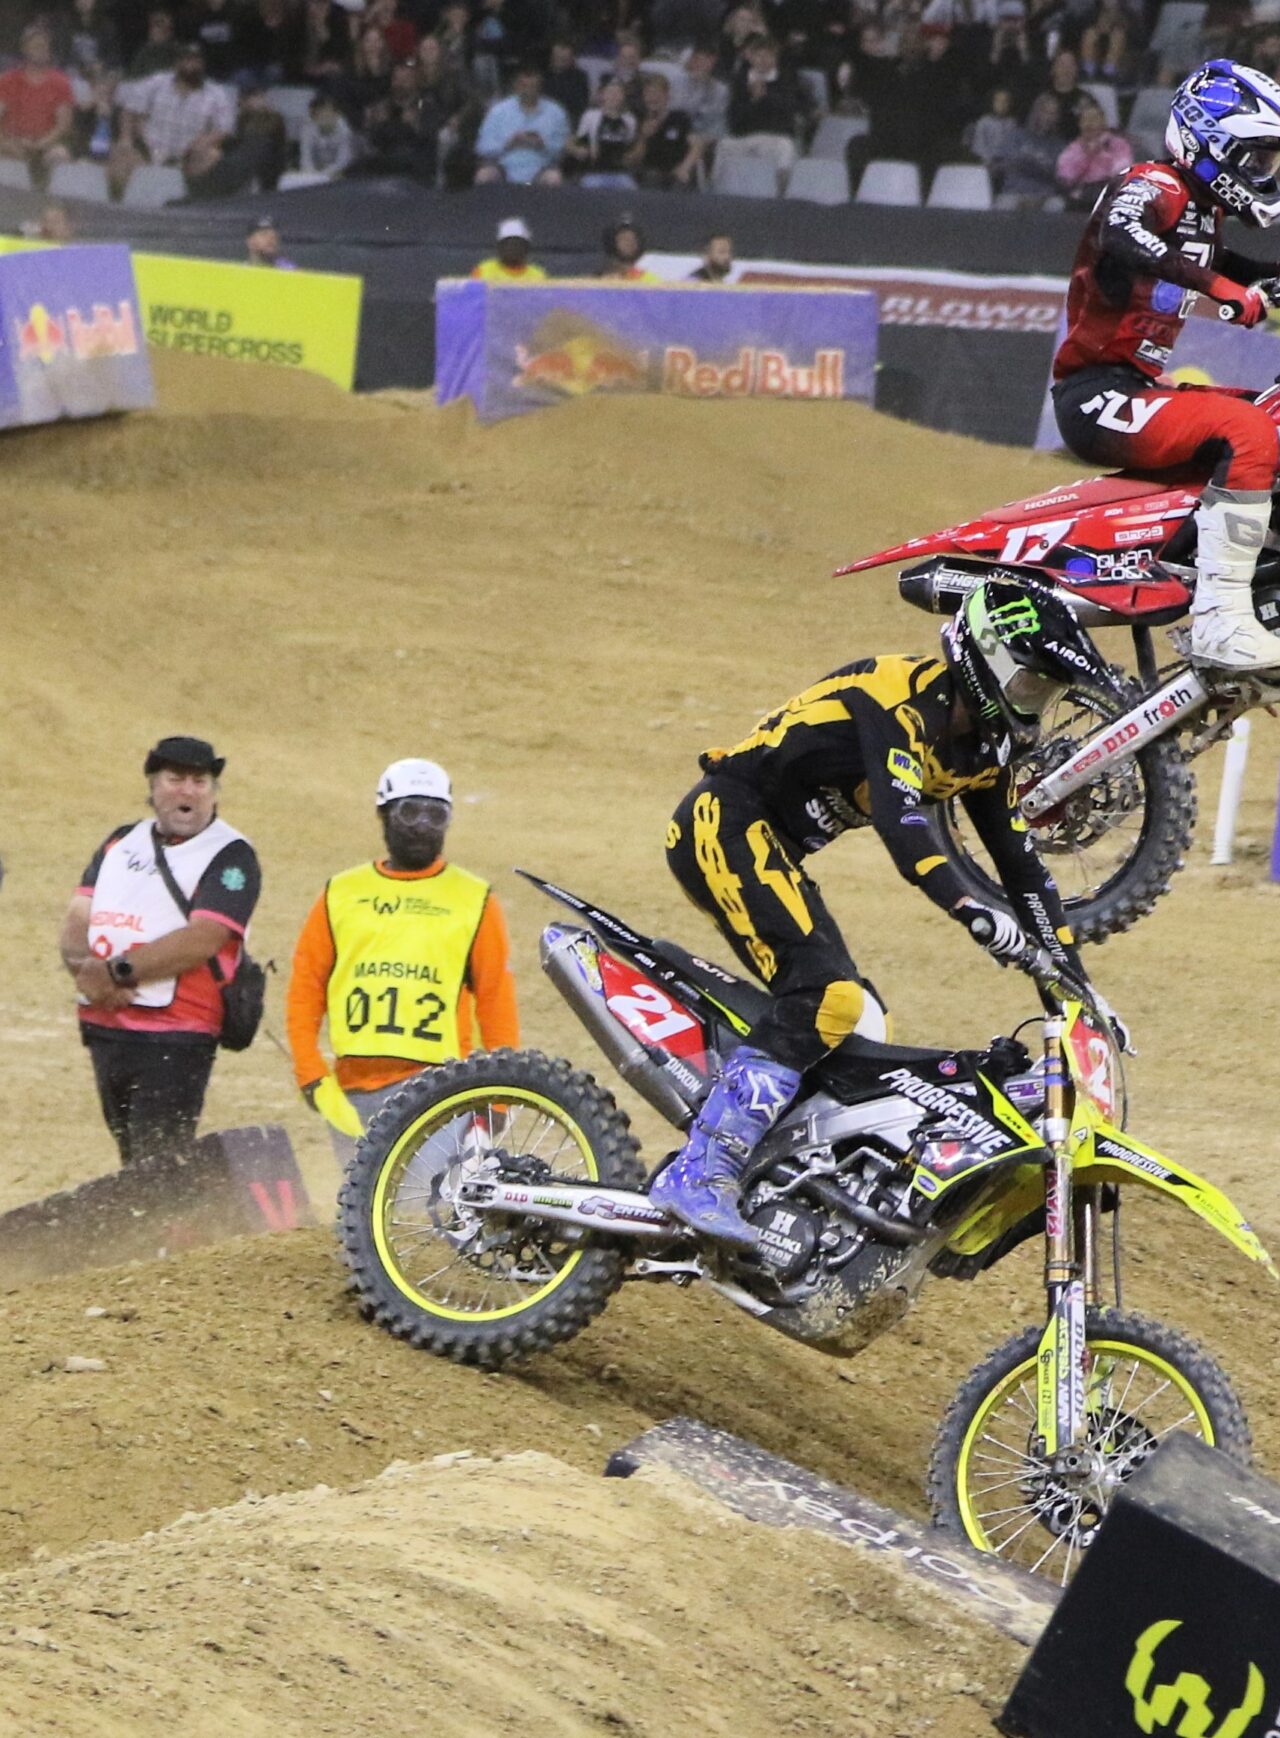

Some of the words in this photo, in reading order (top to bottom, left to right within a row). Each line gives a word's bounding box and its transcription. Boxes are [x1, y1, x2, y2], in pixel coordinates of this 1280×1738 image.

[1210, 180, 1244, 212] LOCK
[1217, 173, 1253, 204] QUAD
[149, 305, 233, 332] WORLD
[147, 331, 304, 364] SUPERCROSS
[664, 346, 754, 395] Red
[759, 347, 844, 397] Bull
[1024, 493, 1079, 511] HONDA
[1000, 518, 1077, 562] 17
[1103, 723, 1139, 753] DID
[1143, 688, 1192, 726] froth
[89, 911, 144, 932] EDICAL
[355, 962, 442, 984] MARSHAL
[346, 986, 447, 1042] 012
[607, 984, 696, 1042] 21
[879, 1068, 1012, 1154] PROGRESSIVE
[1098, 1140, 1173, 1180] PROGRESSIVE
[758, 1229, 802, 1255] UZUKI
[1074, 1323, 1084, 1429] DUNLOP
